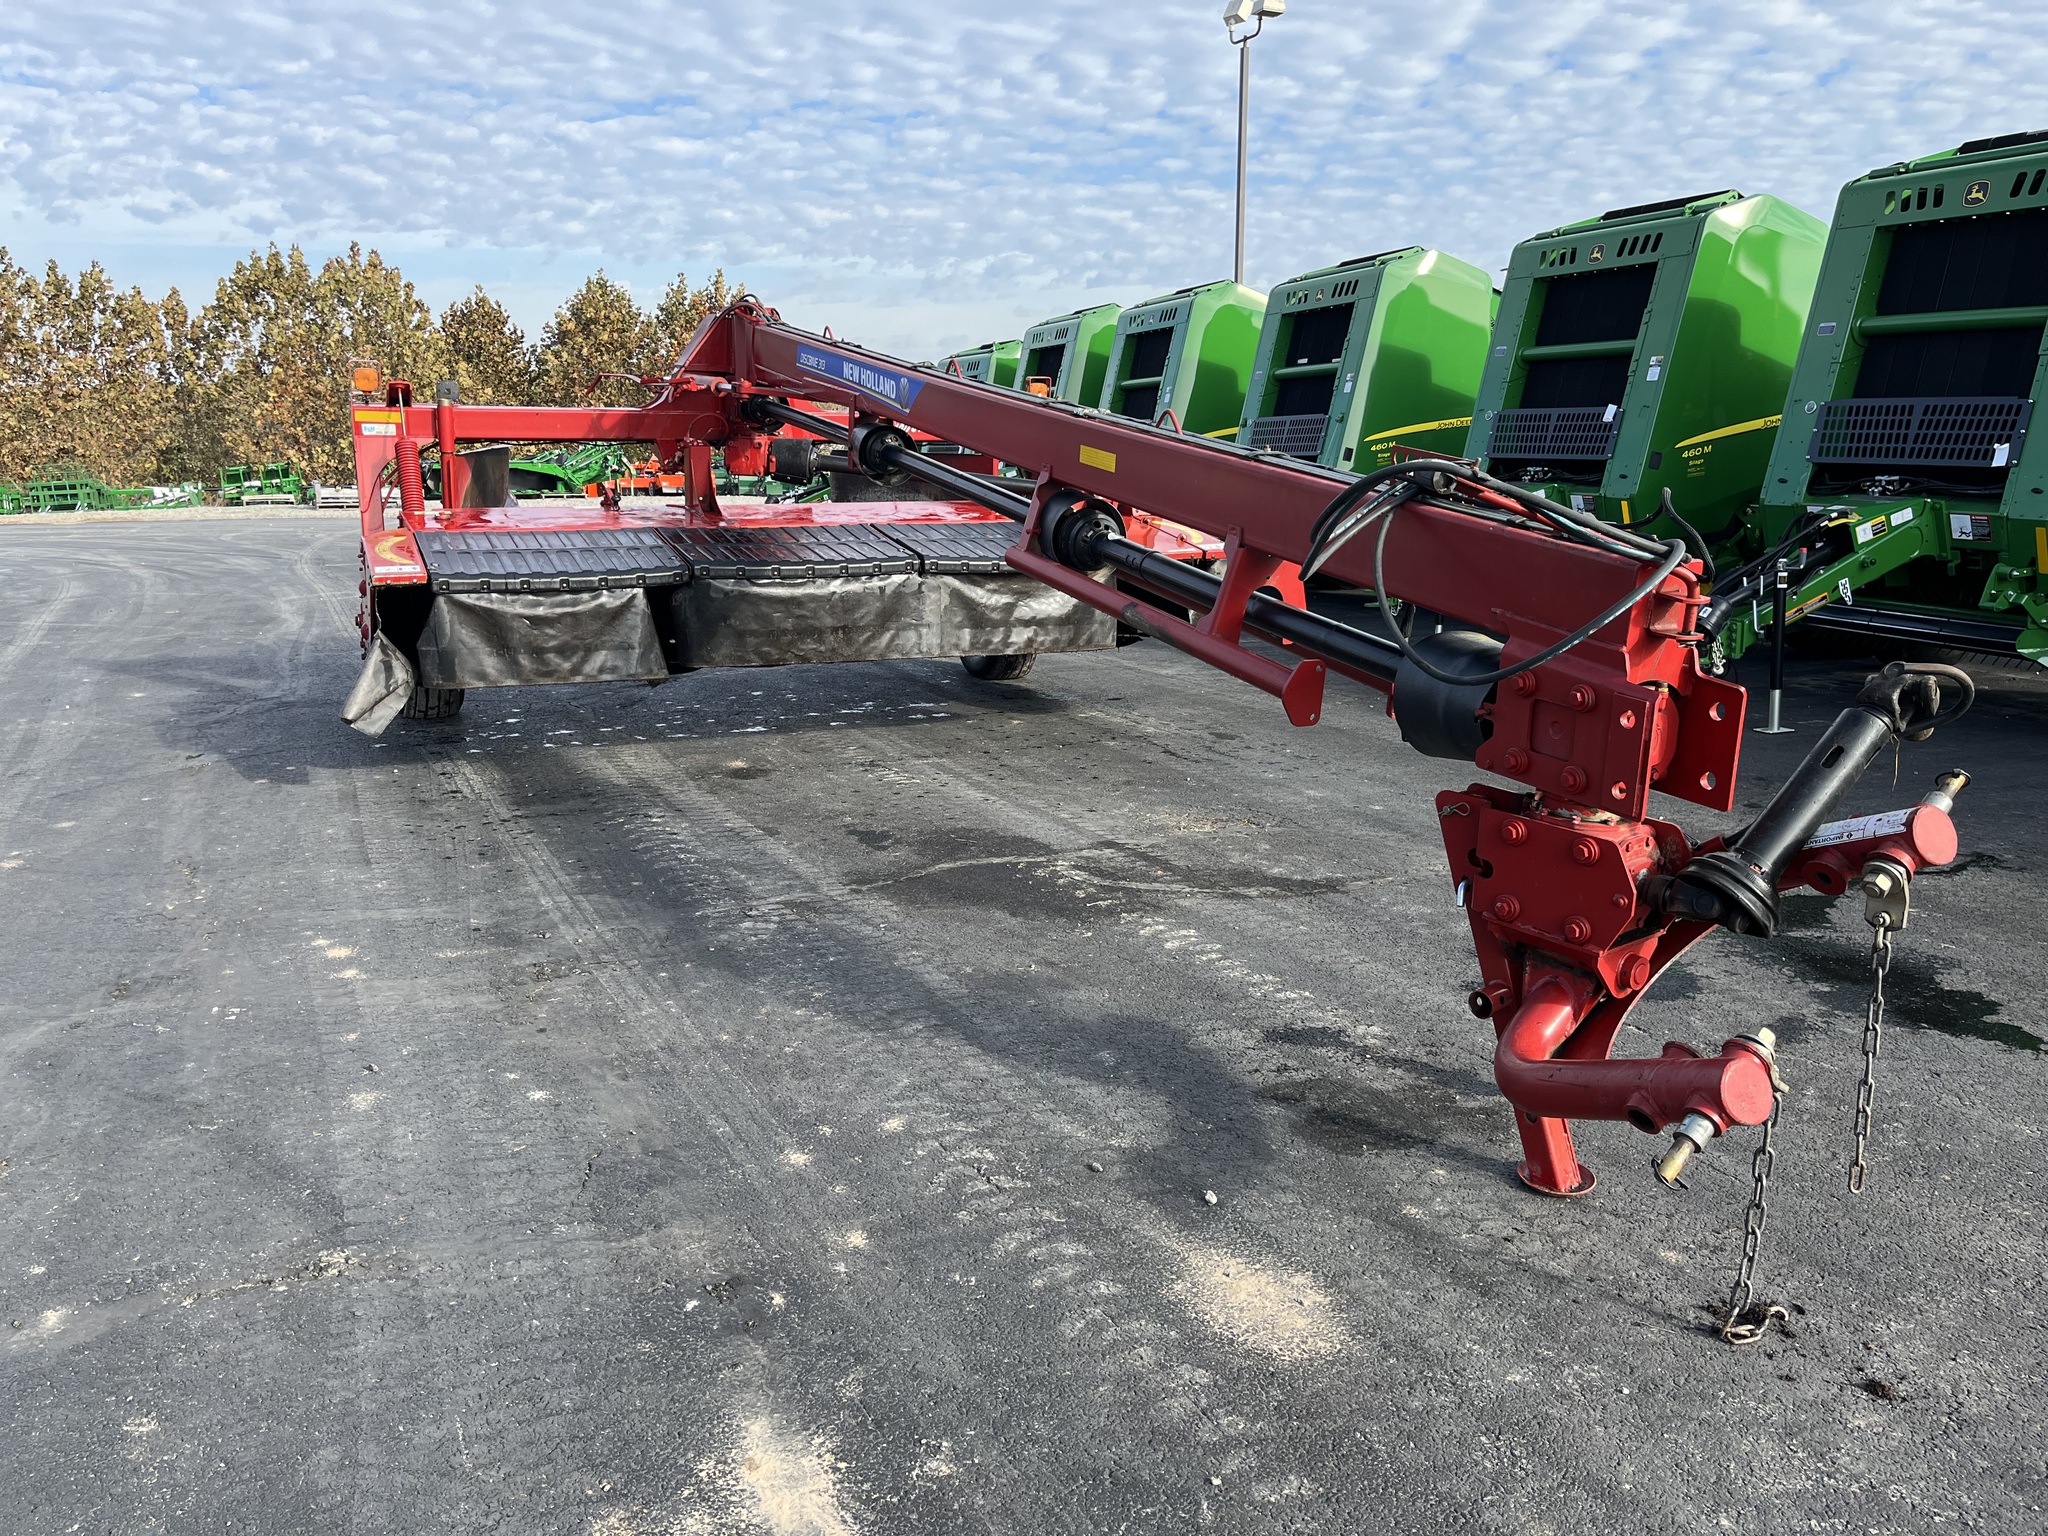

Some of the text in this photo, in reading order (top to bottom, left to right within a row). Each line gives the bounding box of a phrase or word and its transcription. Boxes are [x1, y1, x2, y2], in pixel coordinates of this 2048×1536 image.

[843, 361, 896, 399] NEW HOLLAND
[1436, 420, 1455, 428] JOHN
[1370, 442, 1388, 451] 460
[1682, 445, 1712, 458] 460 M
